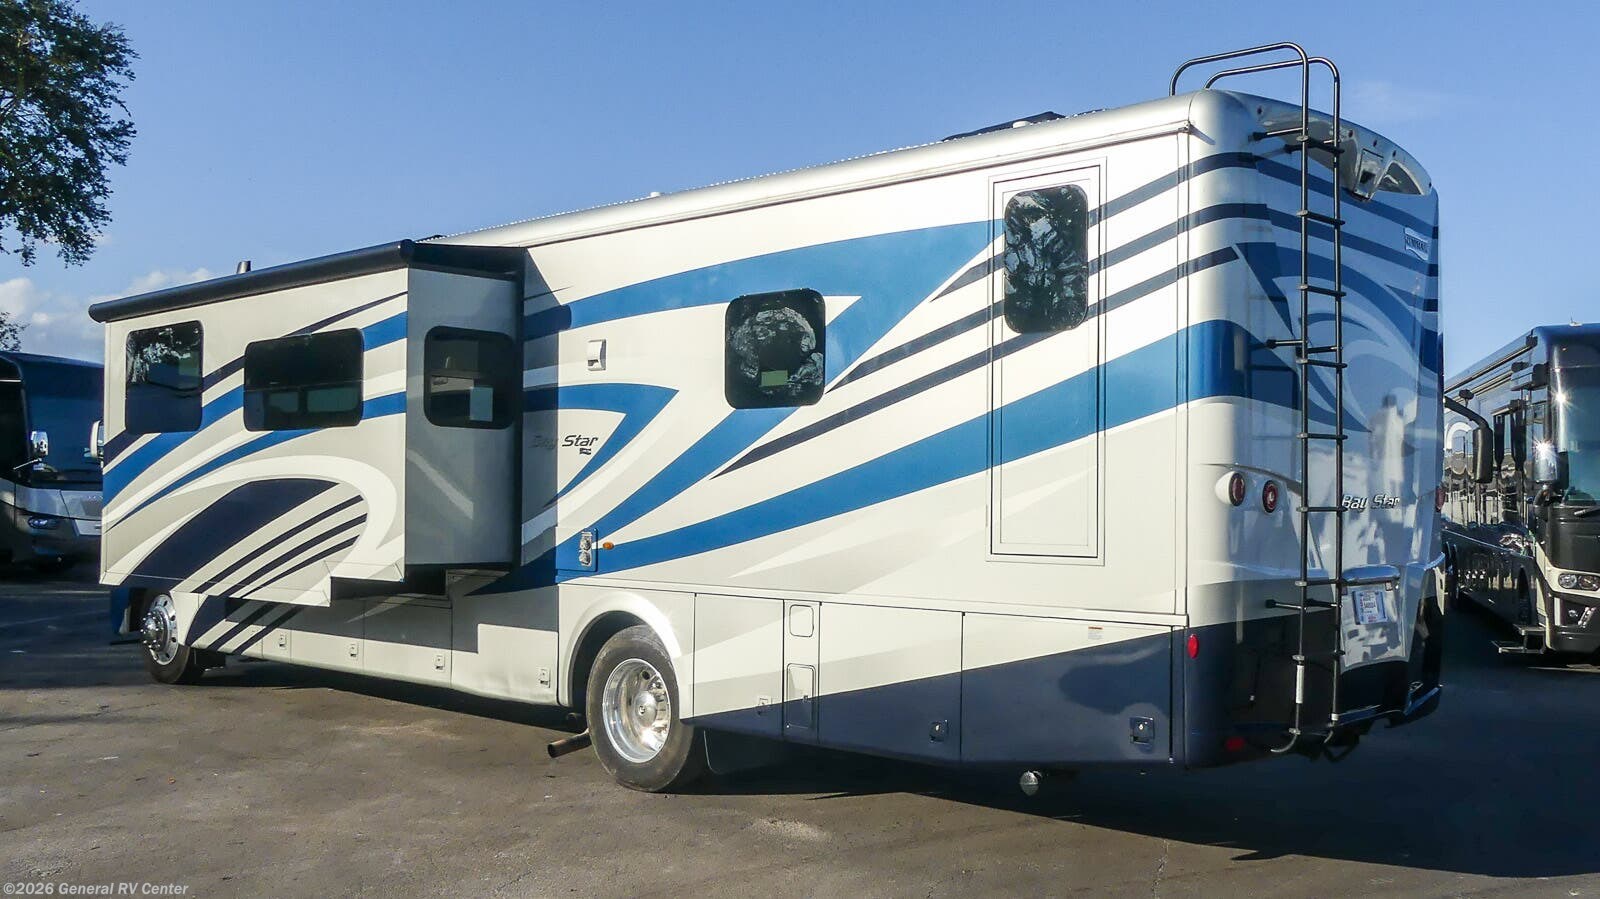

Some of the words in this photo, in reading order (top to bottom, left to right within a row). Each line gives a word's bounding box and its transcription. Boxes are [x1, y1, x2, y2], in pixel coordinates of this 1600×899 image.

[562, 434, 598, 447] Star
[1341, 494, 1369, 513] Bay
[1370, 494, 1400, 509] Star
